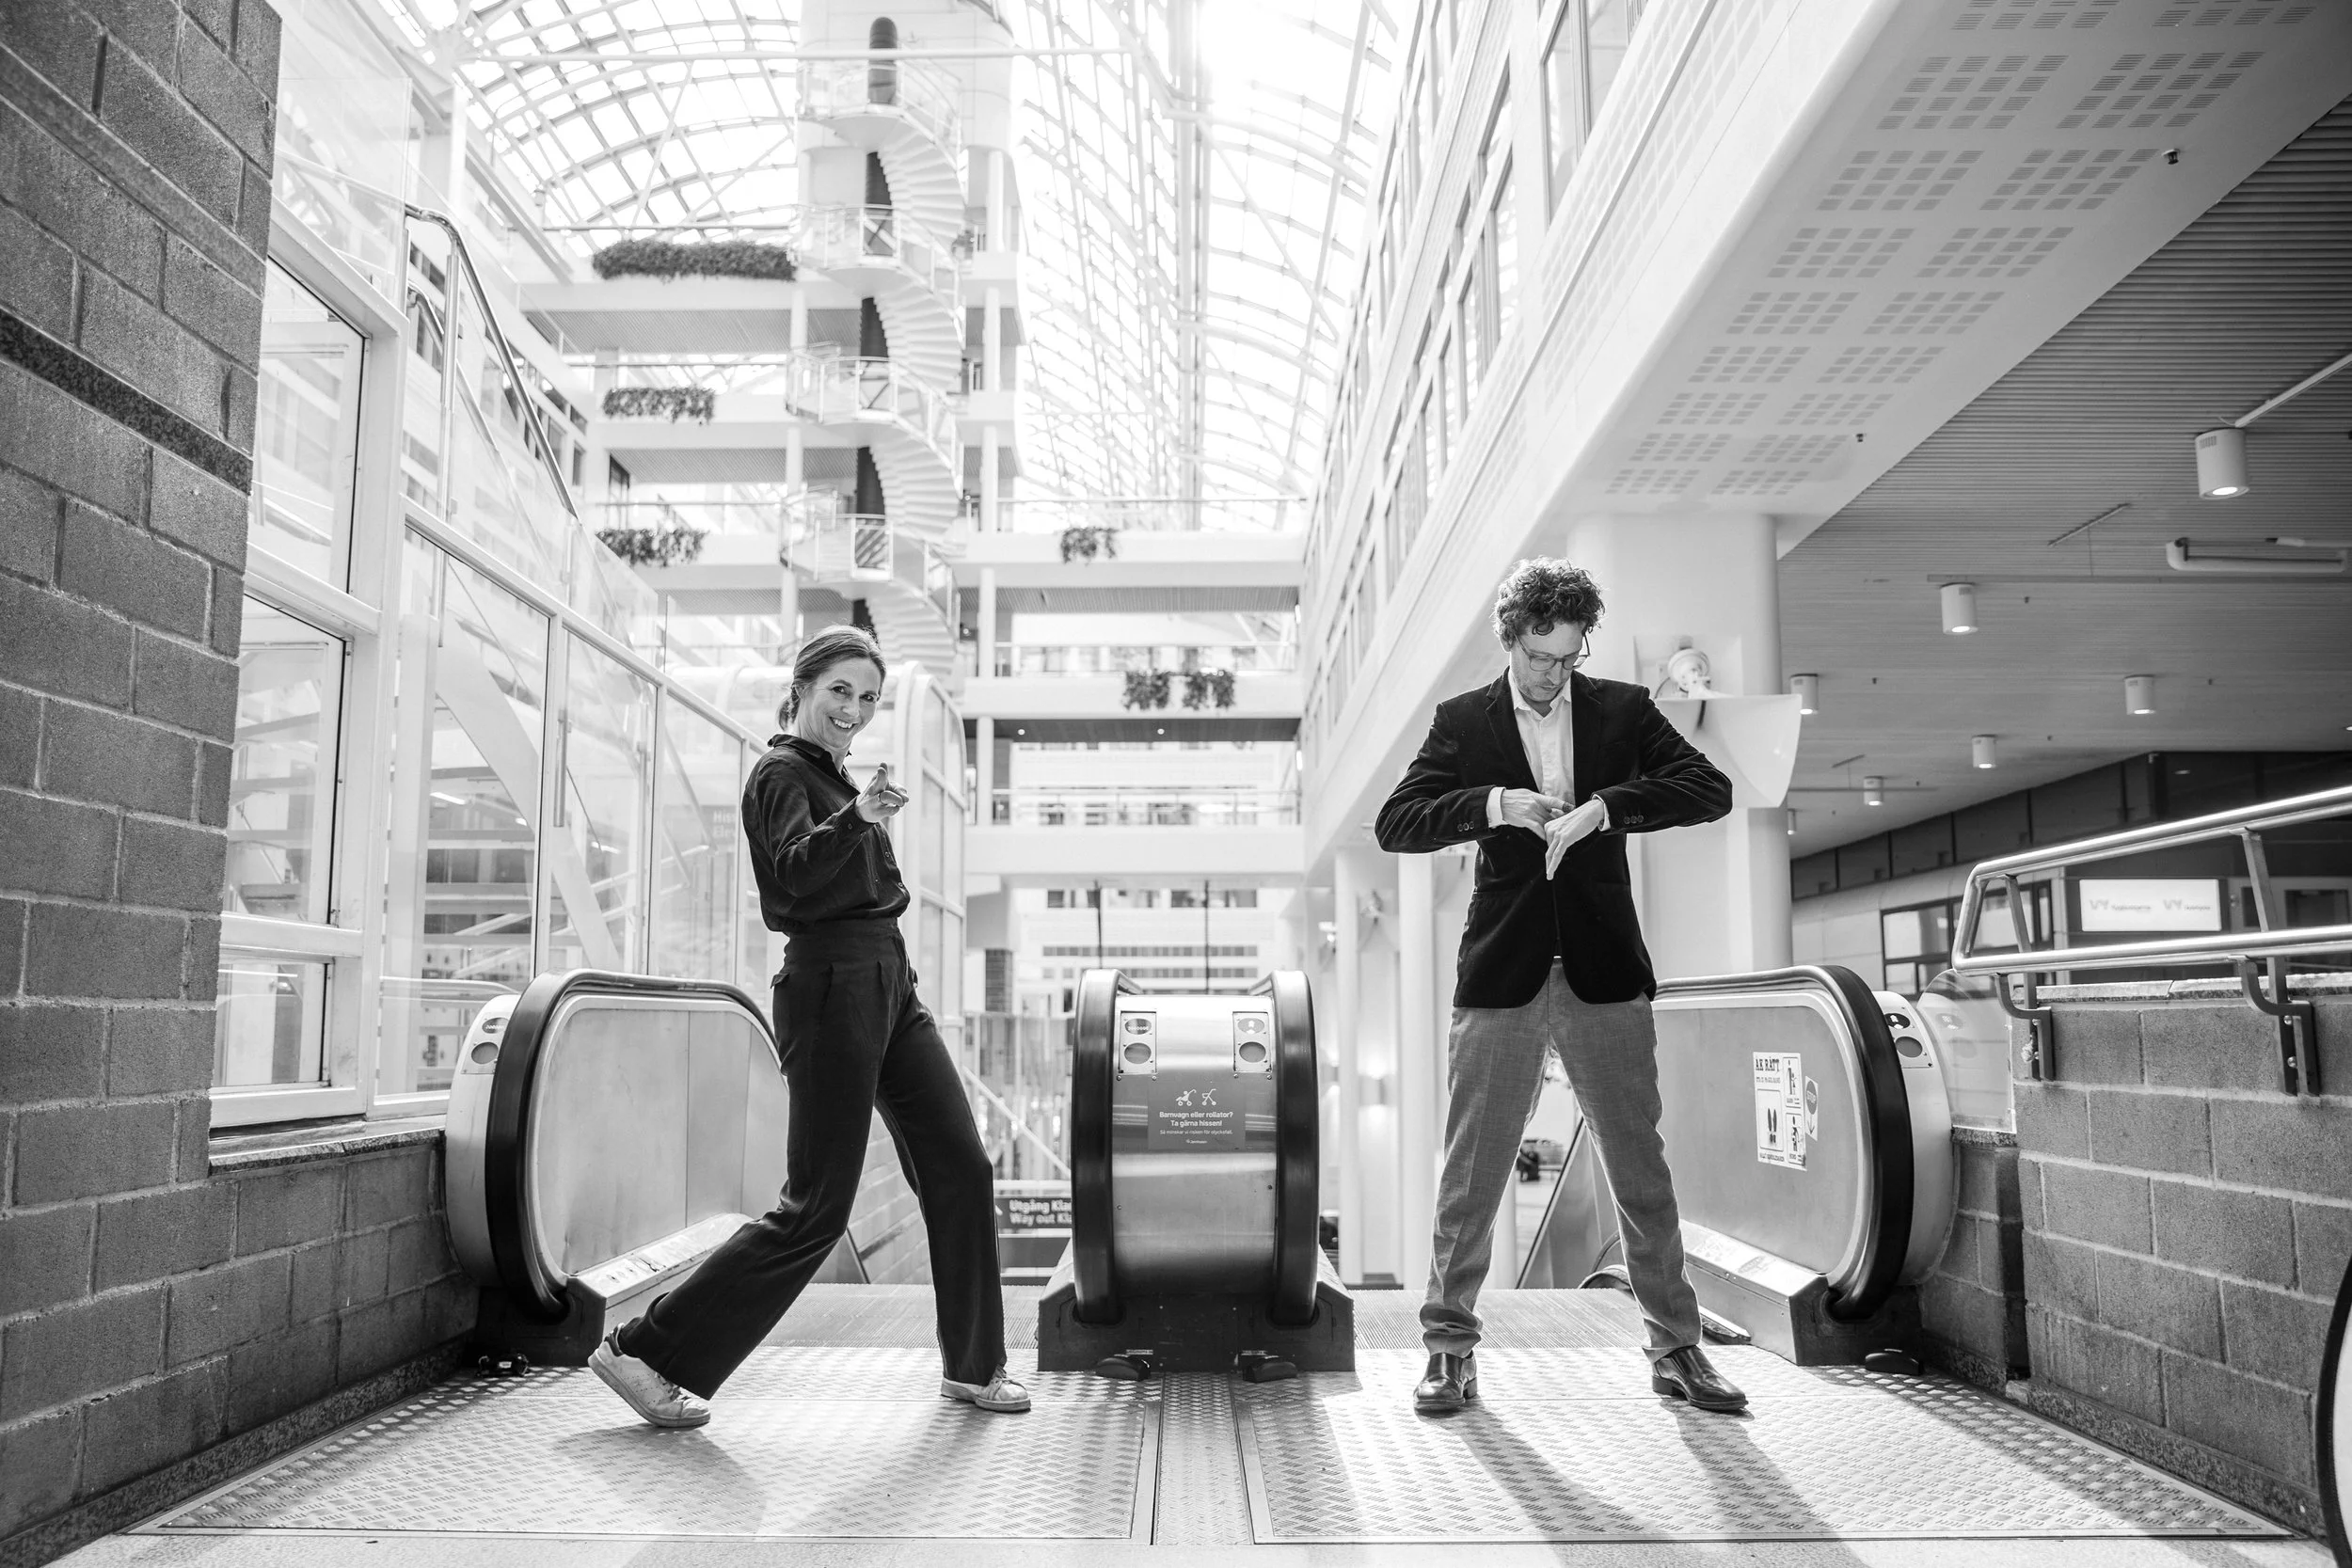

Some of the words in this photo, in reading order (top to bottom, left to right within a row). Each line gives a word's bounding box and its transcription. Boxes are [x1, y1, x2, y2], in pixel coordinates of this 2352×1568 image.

[1179, 1119, 1199, 1128] gärna
[1009, 1199, 1050, 1214] Utgång
[1009, 1212, 1034, 1227] Way
[1036, 1213, 1056, 1224] out
